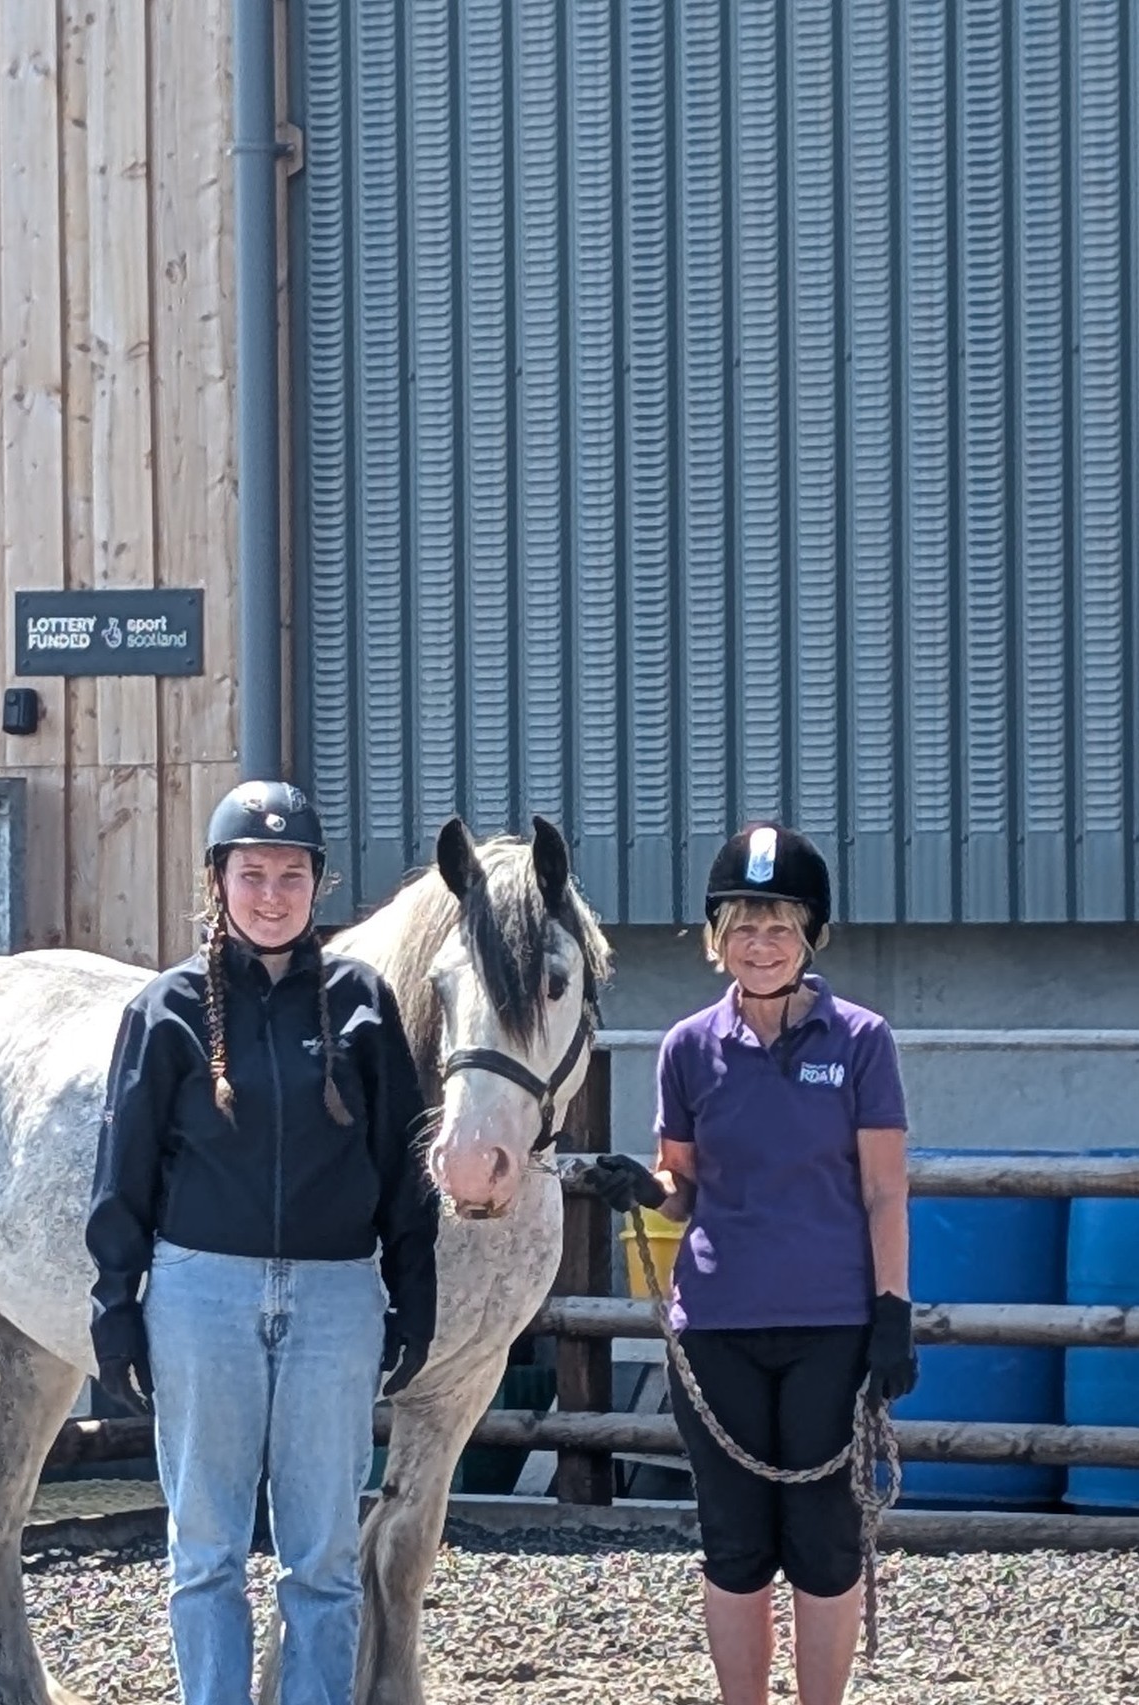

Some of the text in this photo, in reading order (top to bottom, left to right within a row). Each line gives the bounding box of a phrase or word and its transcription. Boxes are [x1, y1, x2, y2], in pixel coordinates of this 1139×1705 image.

[27, 616, 96, 633] LOTTERY
[126, 615, 168, 635] sport
[27, 633, 91, 650] FUNDED
[126, 630, 187, 648] scotland
